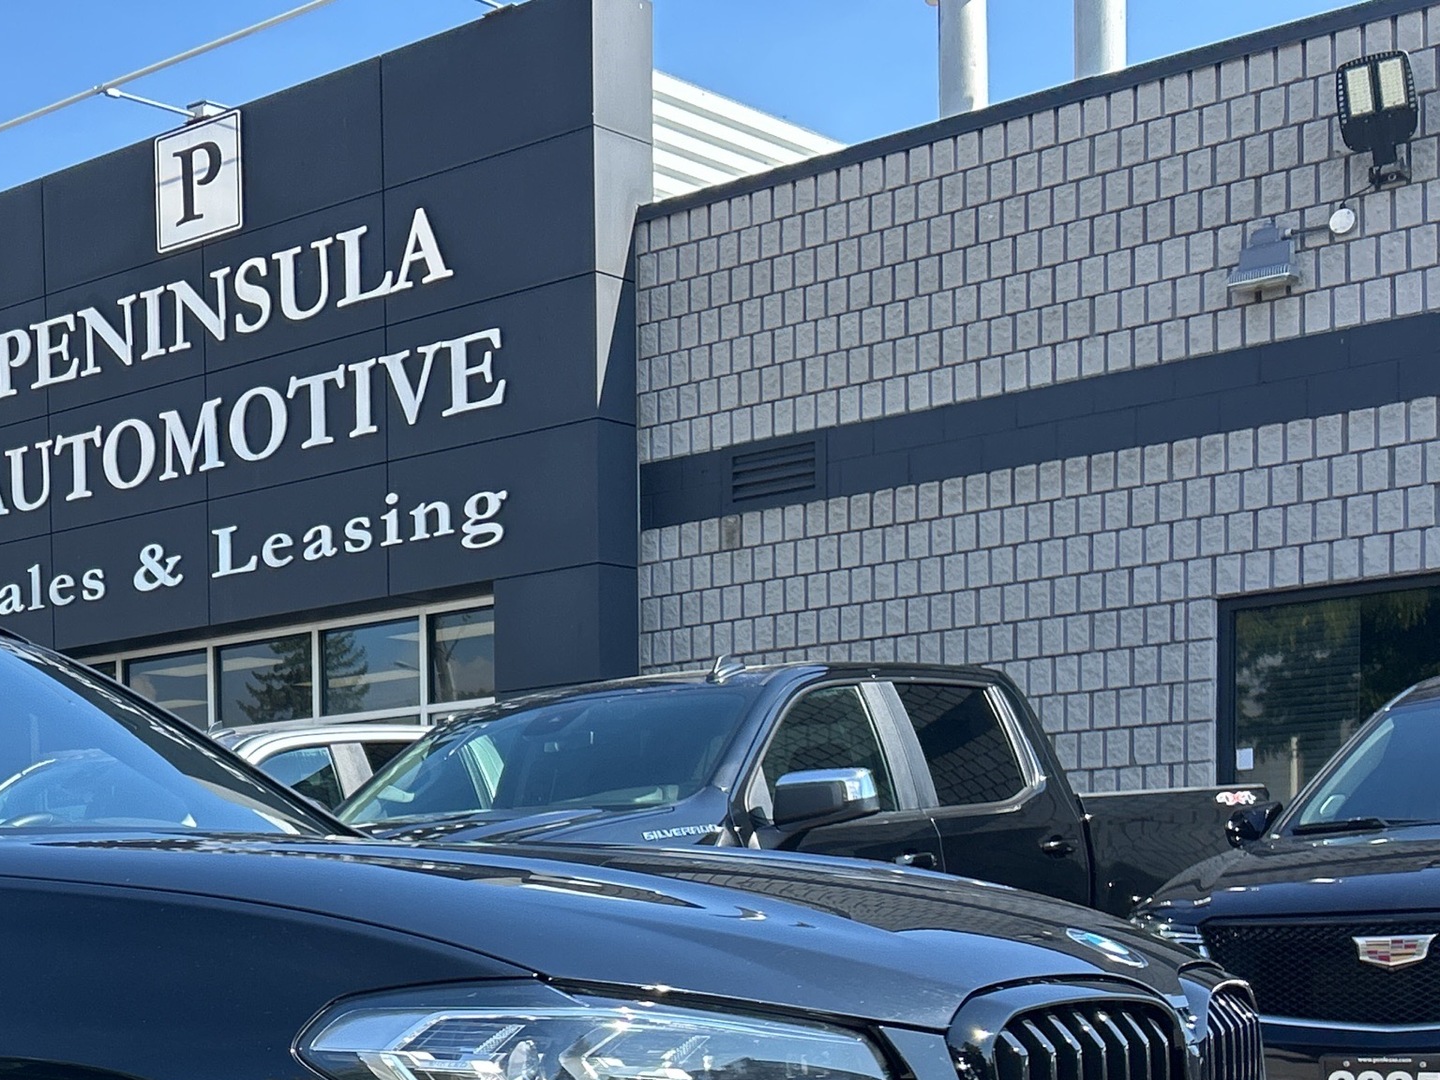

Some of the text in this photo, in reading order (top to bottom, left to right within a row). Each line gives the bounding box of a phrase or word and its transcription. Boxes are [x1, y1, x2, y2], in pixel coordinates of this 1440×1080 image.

[173, 141, 222, 228] P
[133, 543, 183, 592] &
[211, 489, 508, 579] Leasing
[642, 823, 718, 841] SILVERADO
